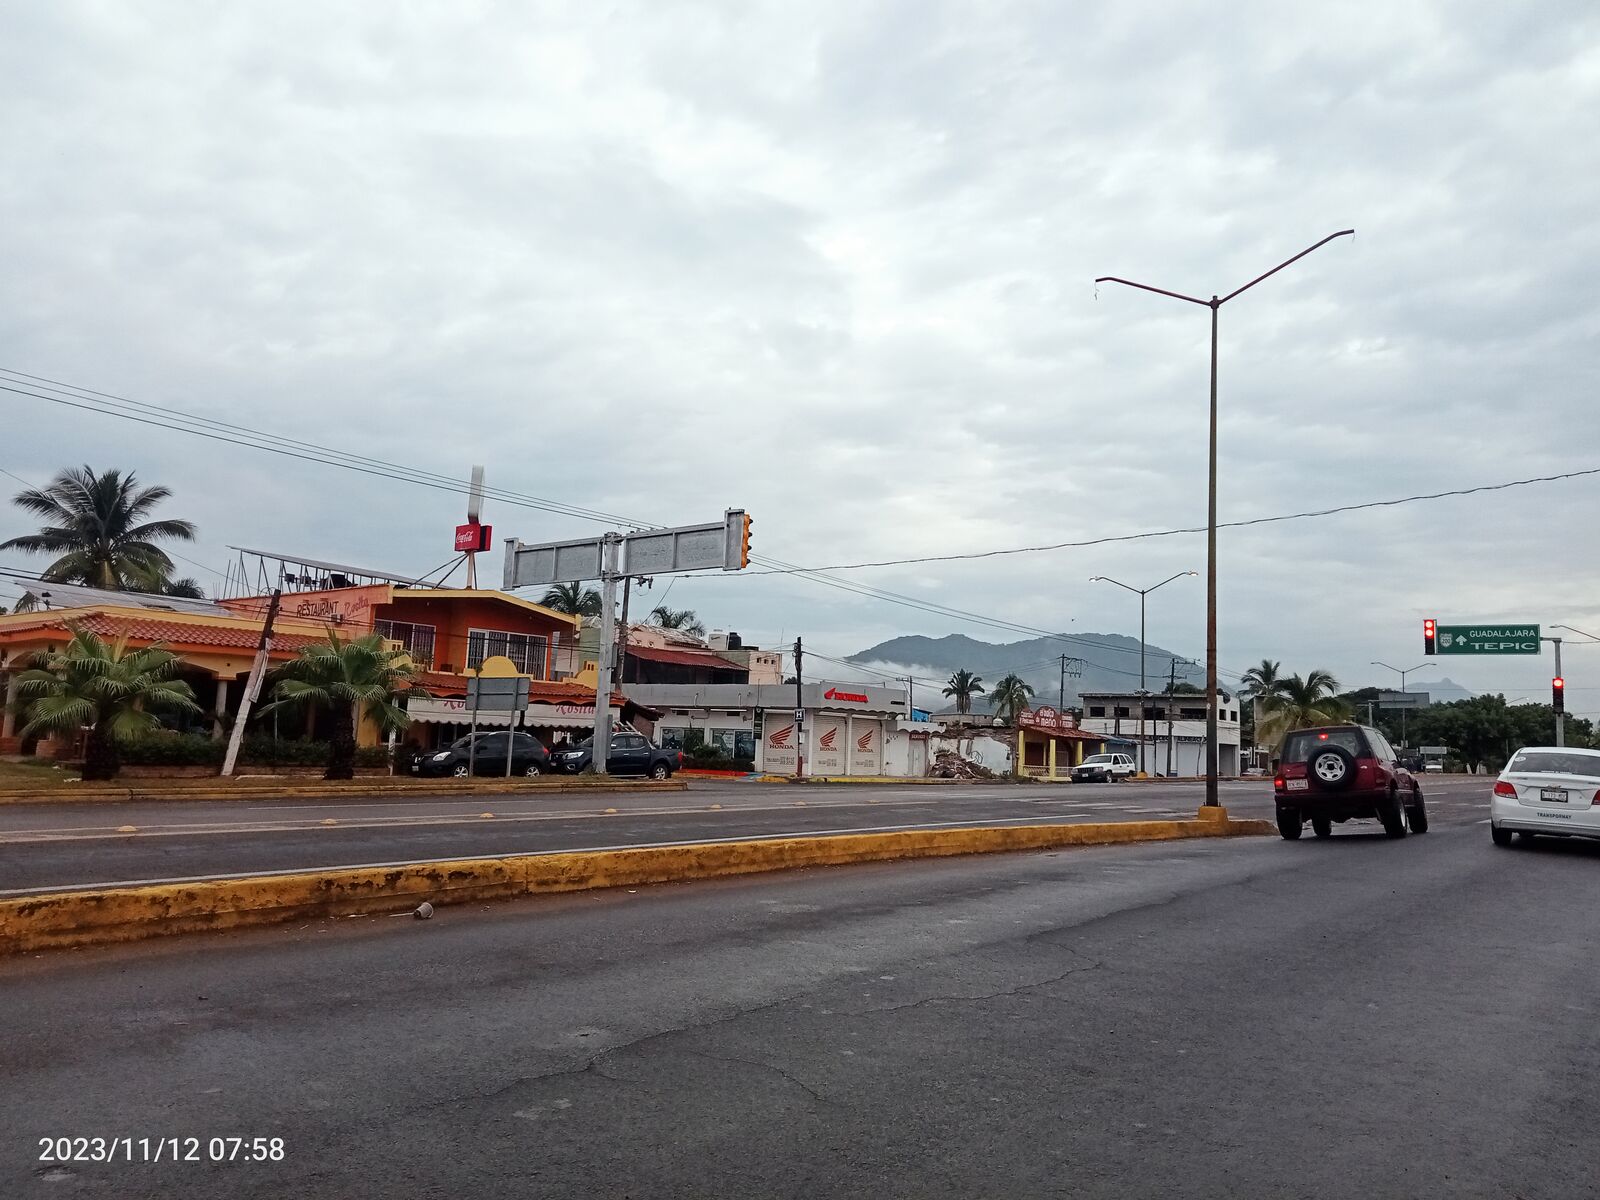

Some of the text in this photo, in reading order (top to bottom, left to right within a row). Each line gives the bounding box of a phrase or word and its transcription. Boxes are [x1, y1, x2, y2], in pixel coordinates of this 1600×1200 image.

[297, 600, 339, 617] RESTAURANT
[1469, 630, 1536, 638] GUADALAJARA
[1470, 642, 1536, 650] TEPIC
